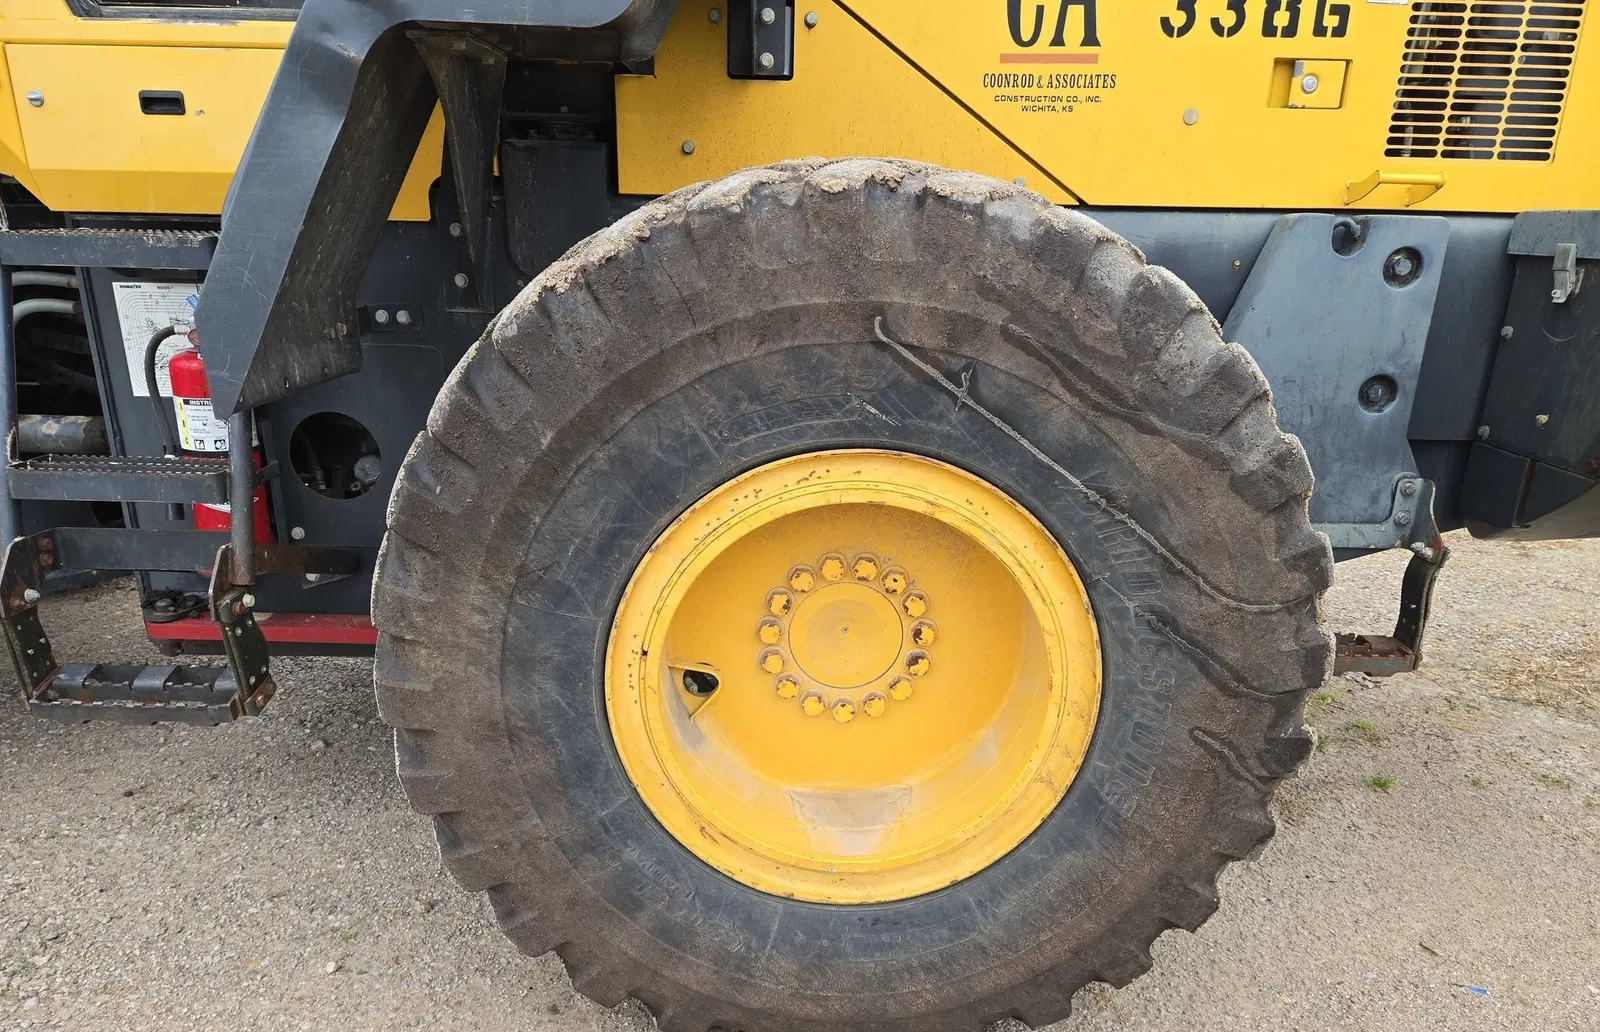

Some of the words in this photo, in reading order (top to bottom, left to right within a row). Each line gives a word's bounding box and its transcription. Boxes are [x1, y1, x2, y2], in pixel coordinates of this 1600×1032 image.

[983, 72, 1035, 89] COONROD
[1036, 74, 1044, 89] &
[1046, 73, 1117, 90] ASSOCIATES
[994, 94, 1064, 103] CONSTRUCTION
[1066, 95, 1083, 104] CO.,
[1085, 95, 1102, 103] INC.
[1021, 104, 1059, 114] WICHITA,
[1062, 105, 1074, 113] KS
